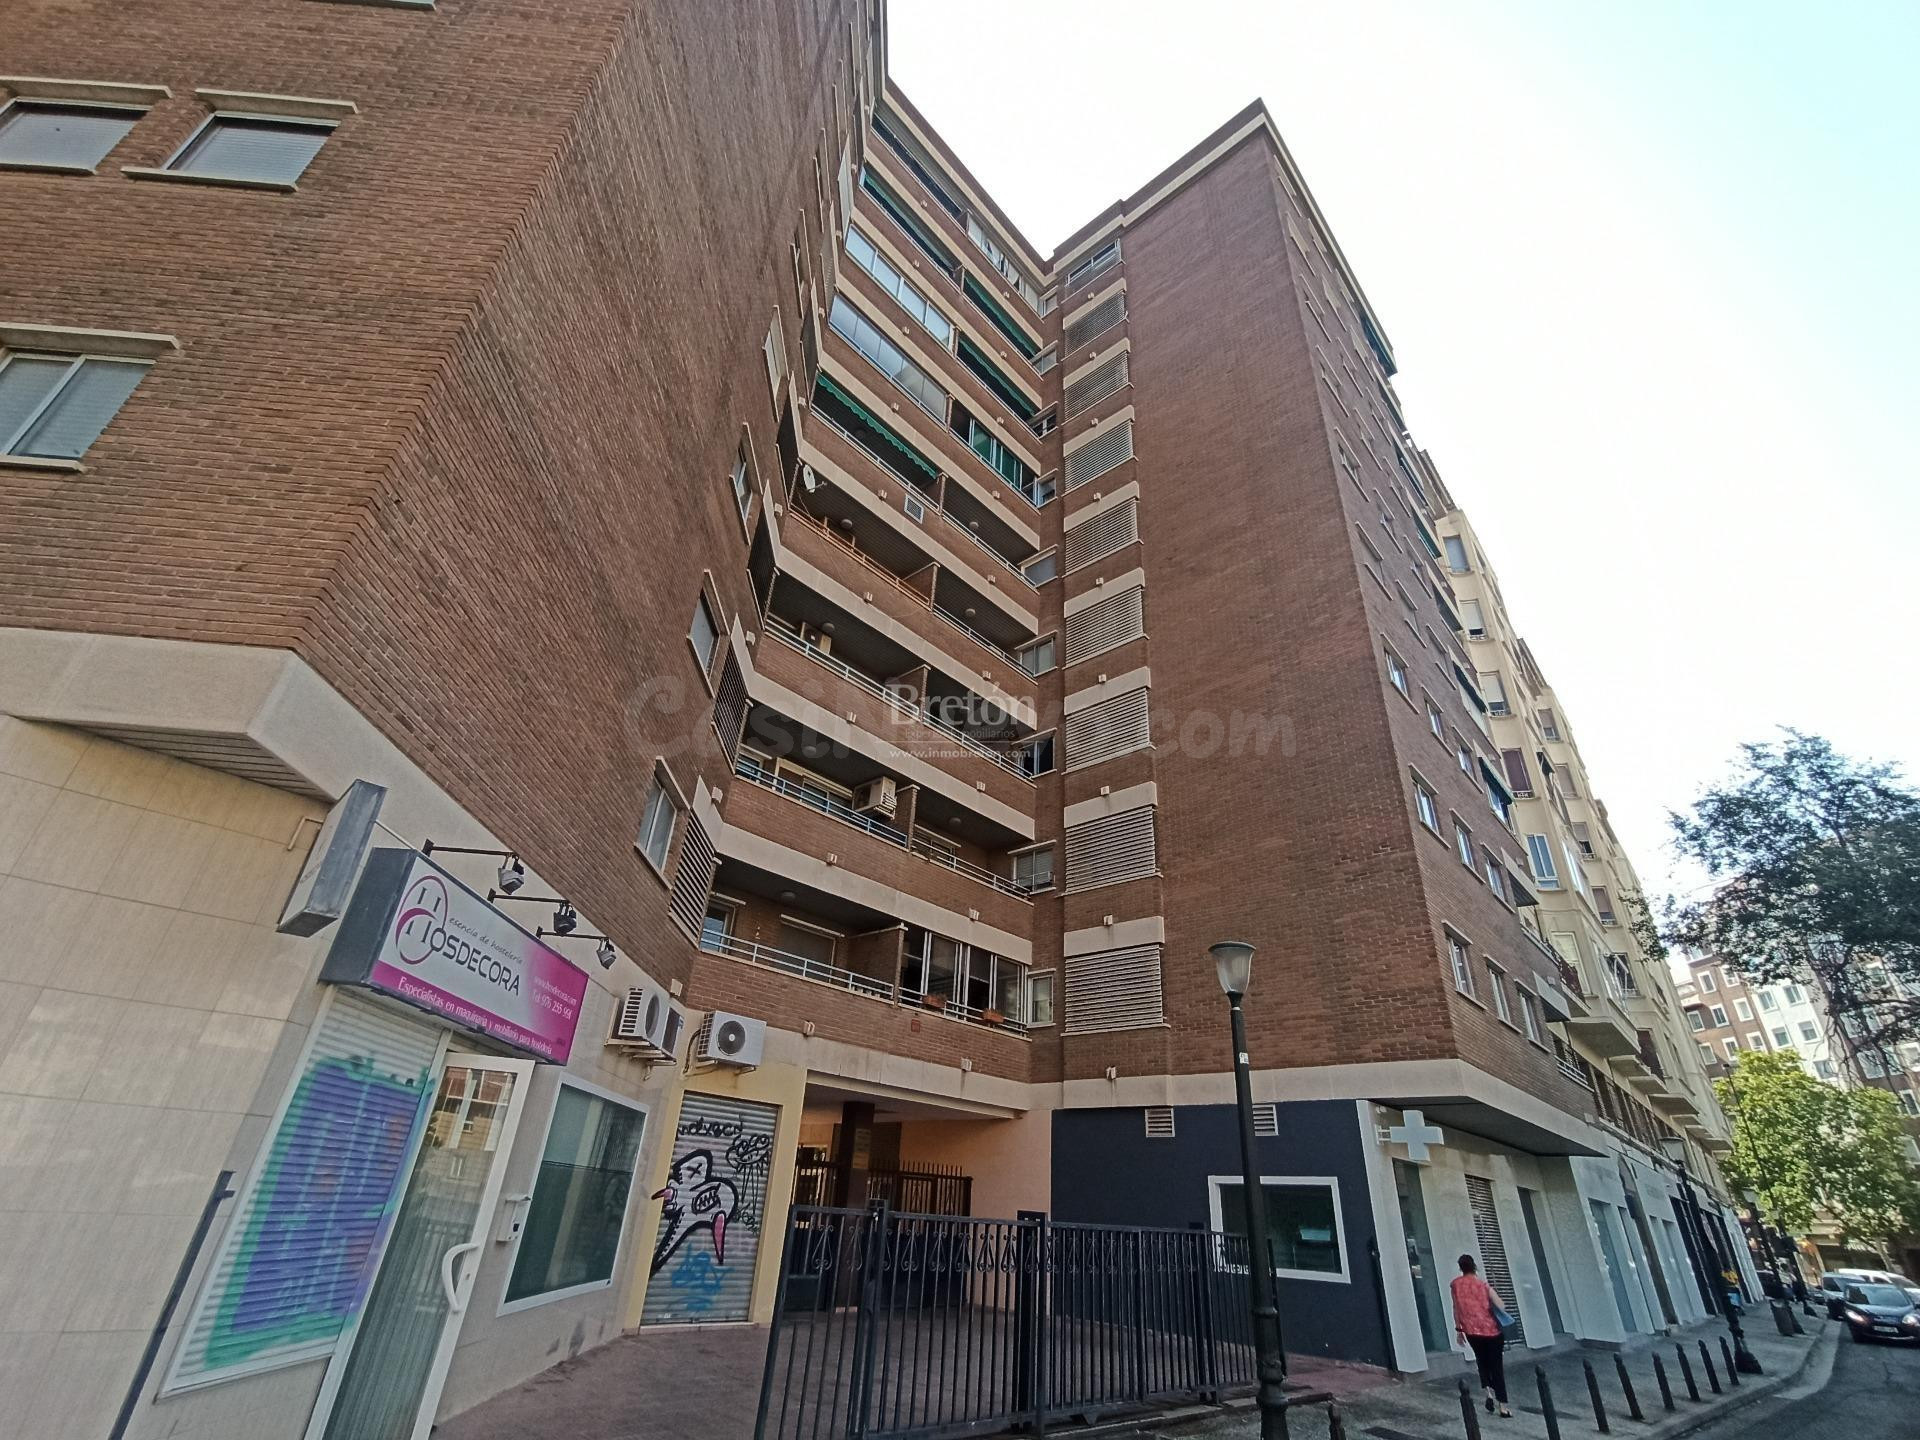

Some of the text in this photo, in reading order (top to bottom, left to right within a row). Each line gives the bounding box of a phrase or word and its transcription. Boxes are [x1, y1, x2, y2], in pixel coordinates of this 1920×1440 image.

[398, 976, 444, 1008] Especialistas
[445, 1001, 455, 1013] en
[455, 1006, 488, 1027] maquinaria
